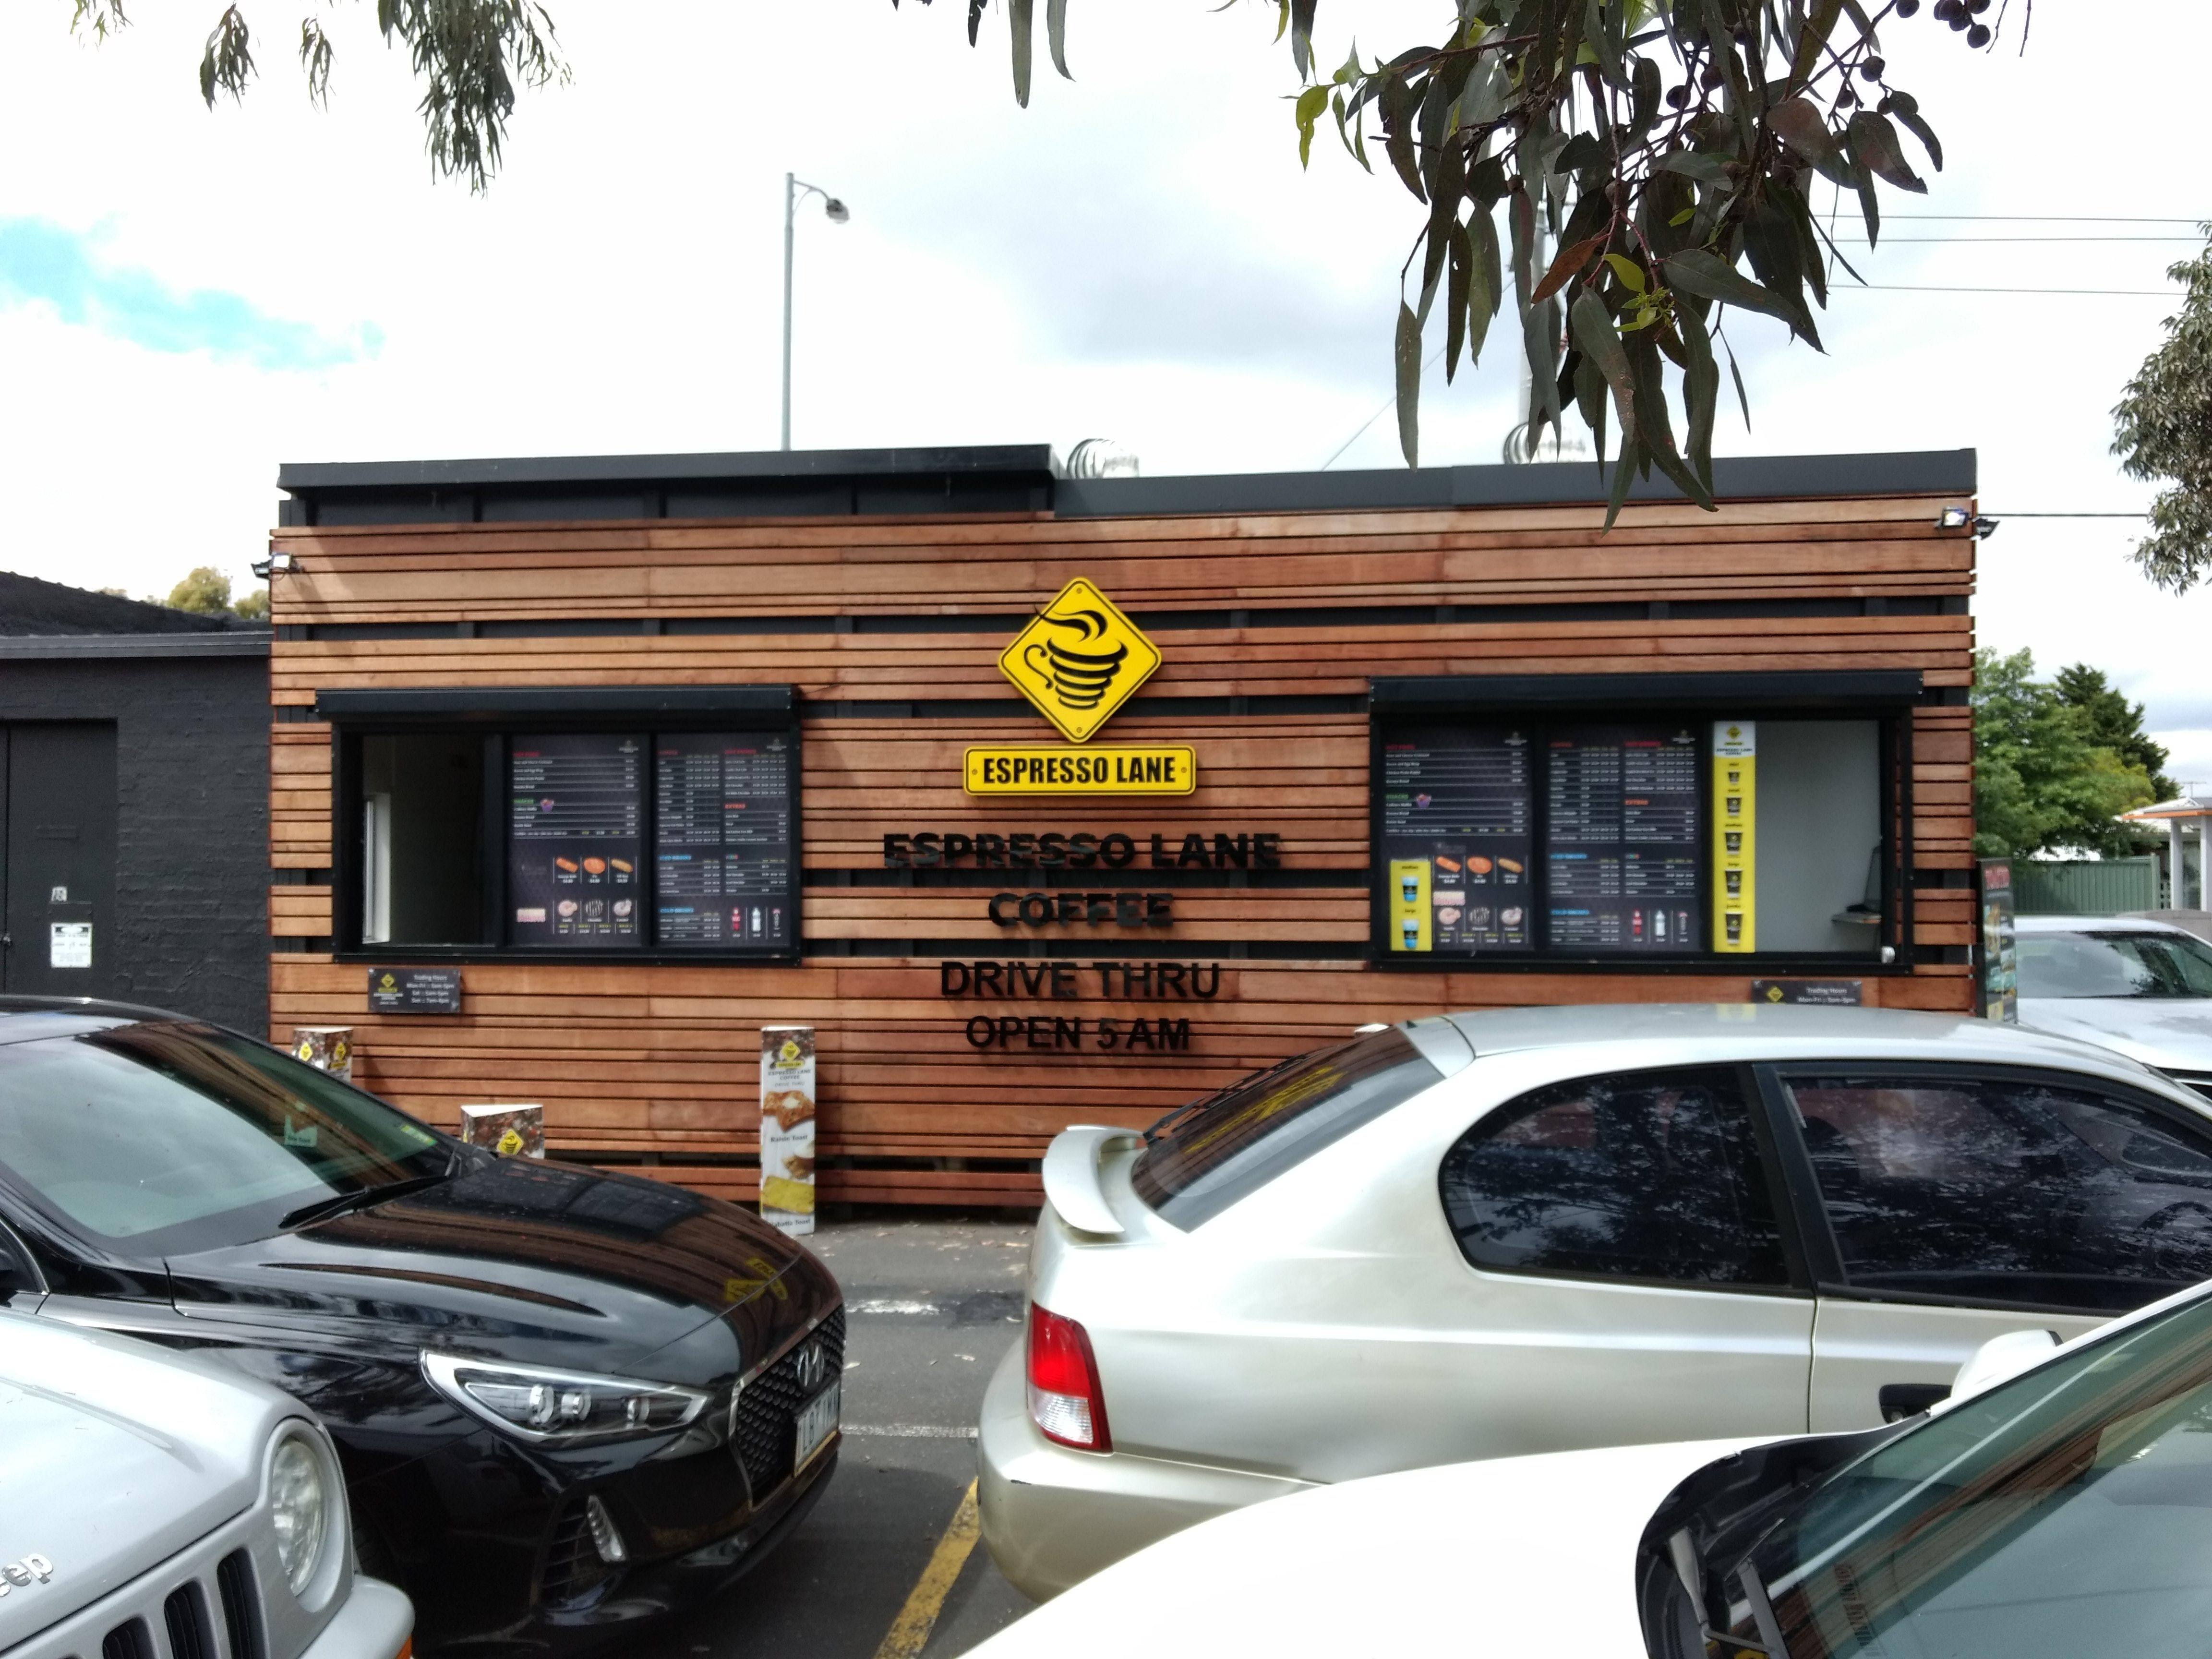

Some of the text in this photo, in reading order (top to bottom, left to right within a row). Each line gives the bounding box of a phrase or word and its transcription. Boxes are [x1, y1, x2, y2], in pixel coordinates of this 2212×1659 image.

[983, 756, 1176, 784] ESPRESSO LANE
[884, 833, 1281, 867] ESPRESSO LANE
[988, 893, 1174, 927] COFFEE
[941, 962, 1220, 998] DRIVE THRU
[966, 1016, 1080, 1049] OPEN
